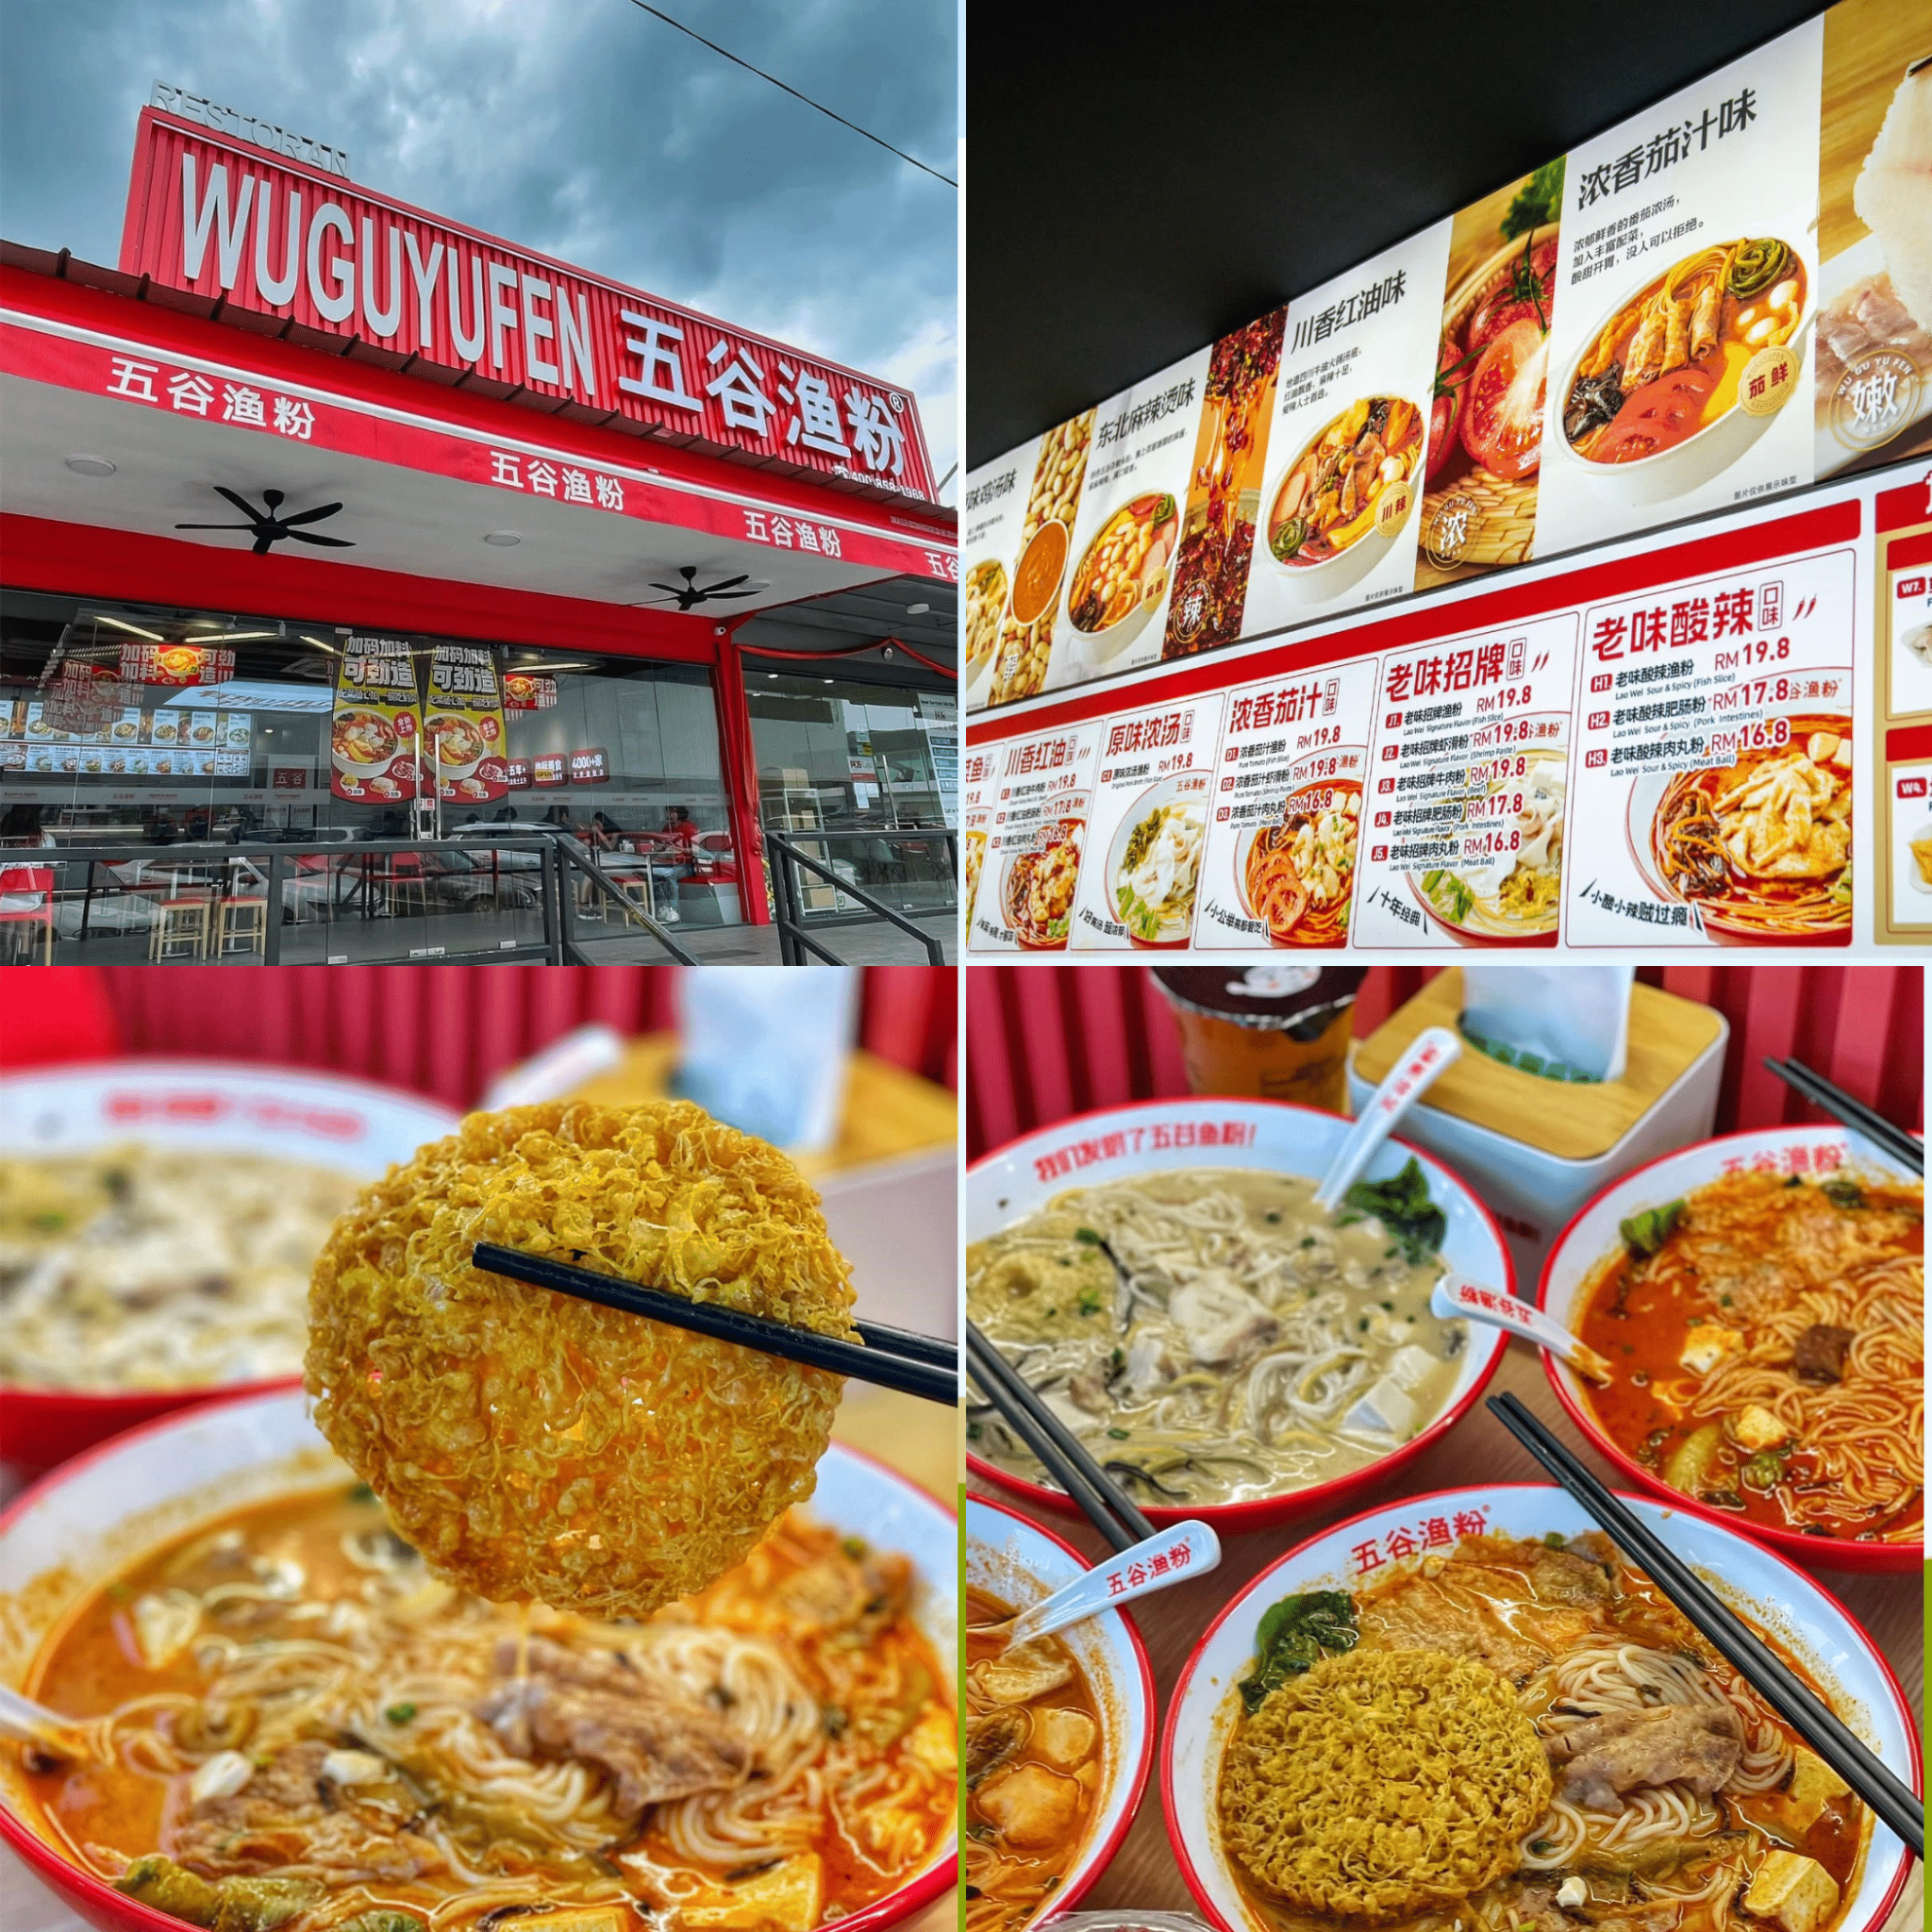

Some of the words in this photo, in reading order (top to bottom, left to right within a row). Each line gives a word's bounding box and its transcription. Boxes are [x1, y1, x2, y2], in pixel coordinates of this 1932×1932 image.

[149, 78, 351, 180] RESTORAN
[1578, 88, 1757, 211] 浓香茄汁味
[182, 152, 595, 395] WUGUYUFEN
[1291, 269, 1407, 355] 川香红油味
[1749, 361, 1789, 400] 茄鲜
[1855, 361, 1871, 375] GU
[1874, 356, 1890, 366] YU
[1893, 358, 1913, 375] FEN
[107, 357, 316, 440] 五谷渔粉
[619, 308, 906, 477] 五谷渔粉
[1852, 371, 1899, 427] 嫩
[1095, 377, 1196, 450] 东北麻辣烫味
[490, 451, 625, 510] 五谷渔粉
[966, 468, 1017, 511] 味鸡汤味
[742, 510, 841, 558] 五谷渔粉
[1591, 587, 1755, 661] 老味酸辣
[346, 636, 411, 658] 加码加料
[1714, 651, 1740, 671] RM
[1742, 637, 1790, 665] 19.8
[344, 657, 415, 688] 可劲造
[432, 664, 497, 694] 可劲造
[1386, 642, 1506, 702] 老味招牌
[1615, 659, 1694, 688] 老味酸辣渔粉
[1476, 696, 1495, 713] RM
[1497, 685, 1532, 708] 19.8
[1615, 690, 1628, 700] Lao
[1629, 688, 1644, 699] Wei
[1646, 686, 1663, 696] Sour
[1670, 681, 1692, 695] Spicy
[1713, 691, 1738, 710] RM
[1740, 677, 1790, 706] 17.8
[1790, 680, 1840, 701] 谷渔粉
[1229, 682, 1323, 733] 浓香茄汁
[1106, 712, 1181, 758] 原味浓汤
[1297, 734, 1312, 750] RM
[1313, 725, 1341, 746] 19.8
[1474, 731, 1491, 747] RM
[1612, 727, 1625, 738] Lao
[1627, 726, 1641, 736] Wei
[1644, 724, 1661, 734] Sour
[1670, 719, 1690, 734] Spicy
[1711, 732, 1736, 752] RM
[1740, 720, 1788, 747] 16.8
[1004, 738, 1067, 777] 川香红油
[1172, 752, 1193, 771] 19.8
[1610, 736, 1705, 764] 老味酸辣肉丸粉
[1292, 767, 1307, 781] RM
[1471, 766, 1489, 782] RM
[1491, 757, 1525, 778] 19.8
[1610, 767, 1624, 776] Lao
[1624, 765, 1639, 774] Wei
[1642, 762, 1658, 773] Sour
[1668, 759, 1689, 773] Spicy
[1288, 797, 1304, 814] RM
[1305, 789, 1333, 810] 16.8
[1467, 803, 1485, 818] RM
[1488, 792, 1524, 815] 17.8
[1464, 839, 1482, 855] RM
[1485, 830, 1520, 852] 16.8
[1106, 1541, 1191, 1598] 五谷渔粉
